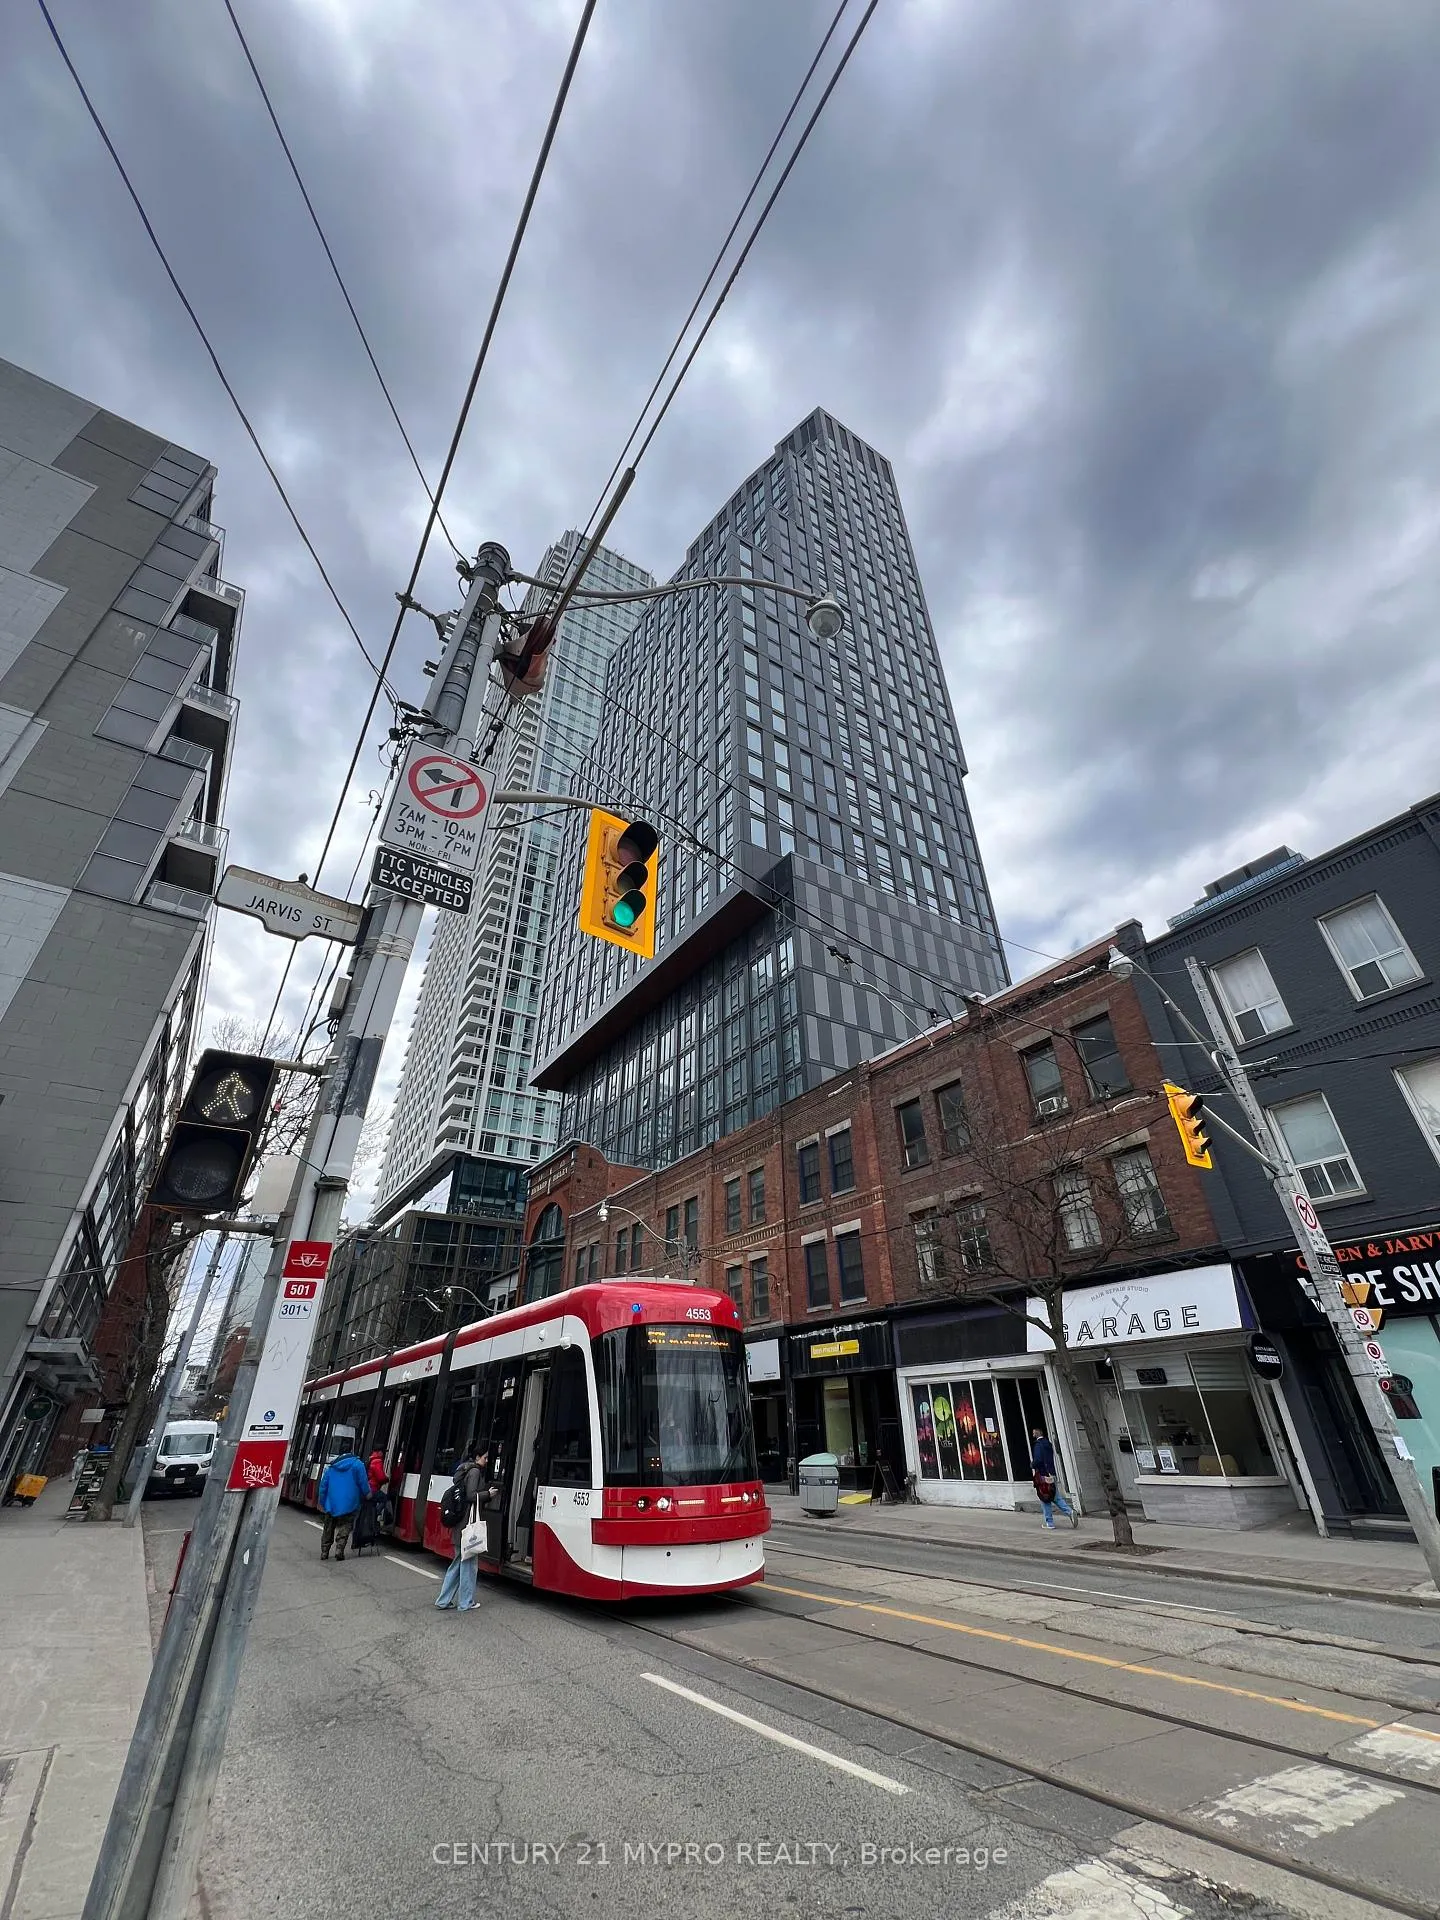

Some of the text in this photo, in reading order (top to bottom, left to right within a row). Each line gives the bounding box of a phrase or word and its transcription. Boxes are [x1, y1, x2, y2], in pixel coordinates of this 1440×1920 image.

[400, 802, 426, 824] 7AM
[443, 820, 476, 842] 10AM
[394, 819, 425, 840] 3PM
[443, 835, 471, 857] 7PM
[408, 840, 430, 852] MON
[437, 850, 451, 860] FRI
[379, 851, 471, 893] TTC VEHICLES
[258, 877, 274, 888] Old
[278, 883, 302, 896] Town
[379, 868, 464, 907] EXCEPTED
[245, 895, 333, 933] JARVIS ST.
[1296, 1246, 1363, 1270] QEN
[1367, 1243, 1383, 1257] &
[289, 1284, 311, 1296] 501
[1090, 1285, 1149, 1301] HAIR REPAIR STUDIO
[281, 1304, 302, 1316] 301
[685, 1307, 712, 1320] 4553
[573, 1491, 590, 1506] 4553
